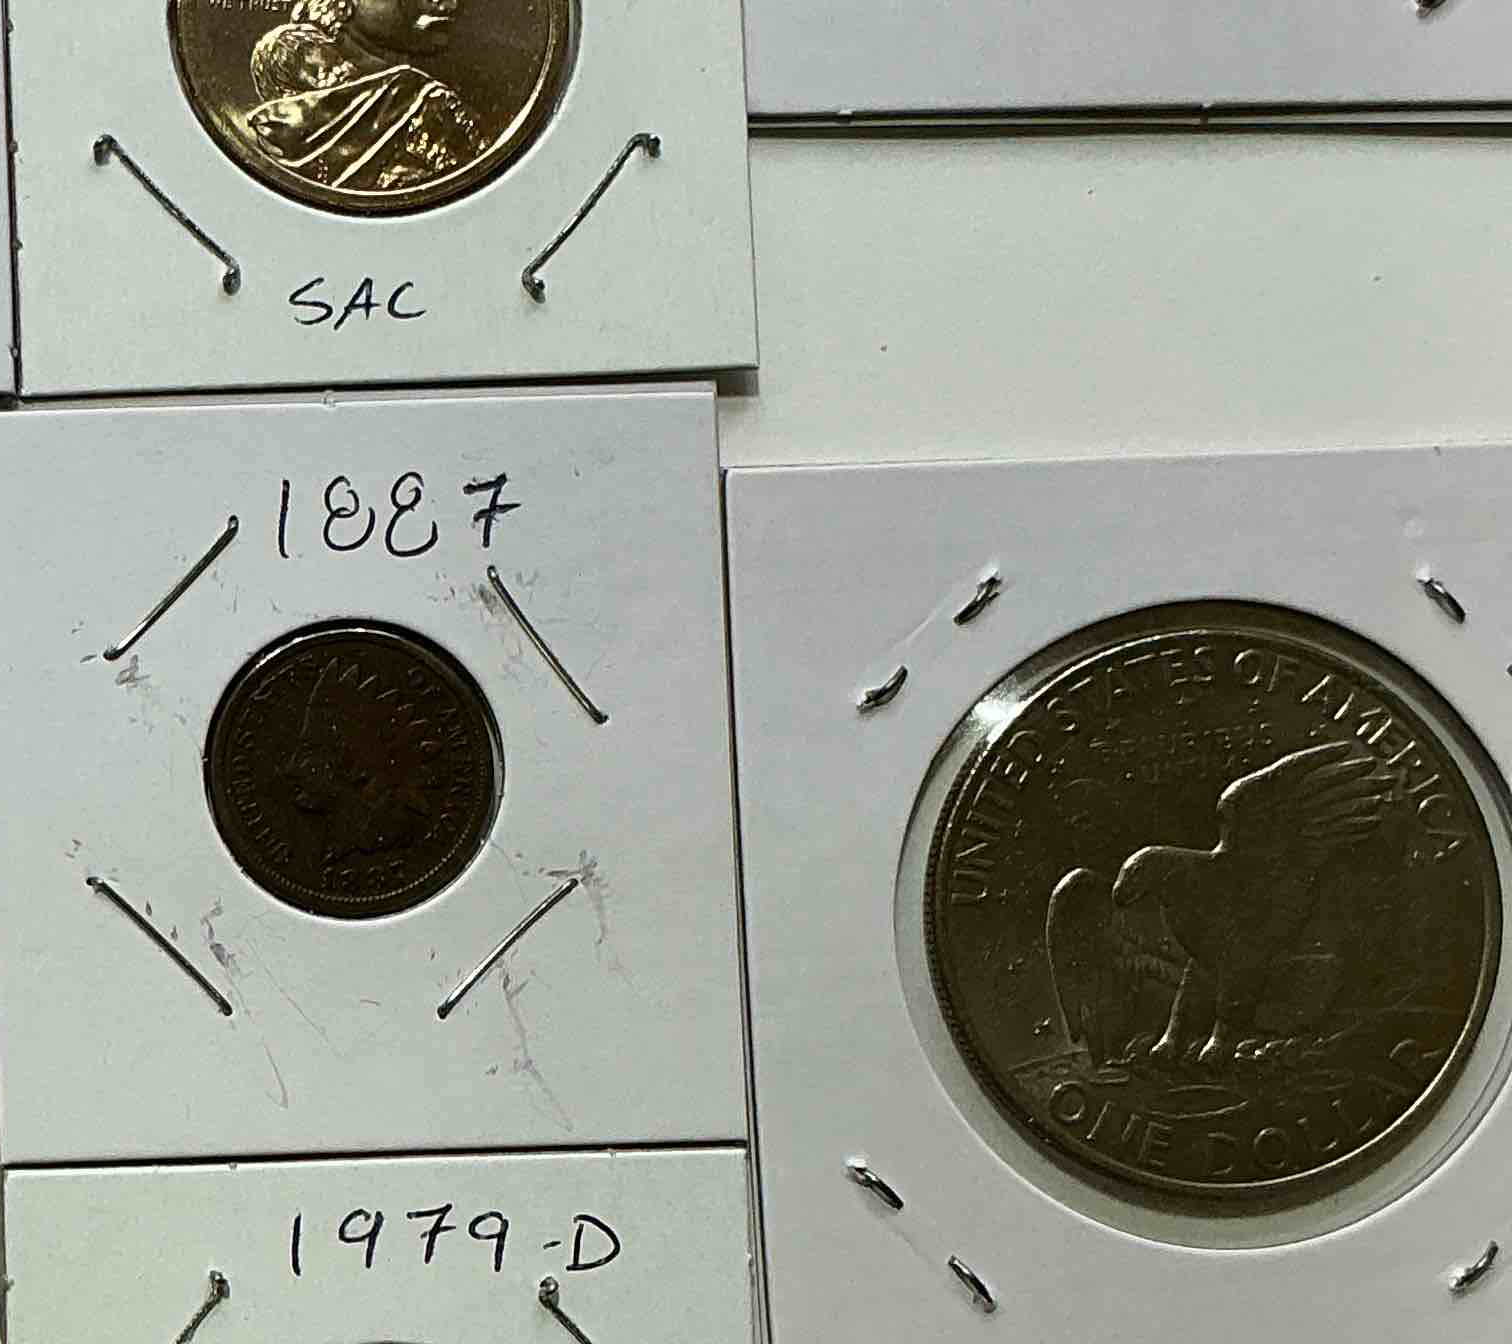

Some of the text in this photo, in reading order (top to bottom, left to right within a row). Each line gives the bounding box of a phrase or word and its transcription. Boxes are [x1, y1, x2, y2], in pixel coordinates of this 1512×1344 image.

[288, 278, 428, 330] SAC
[277, 471, 522, 559] 1887
[289, 1204, 622, 1273] 1979-D
